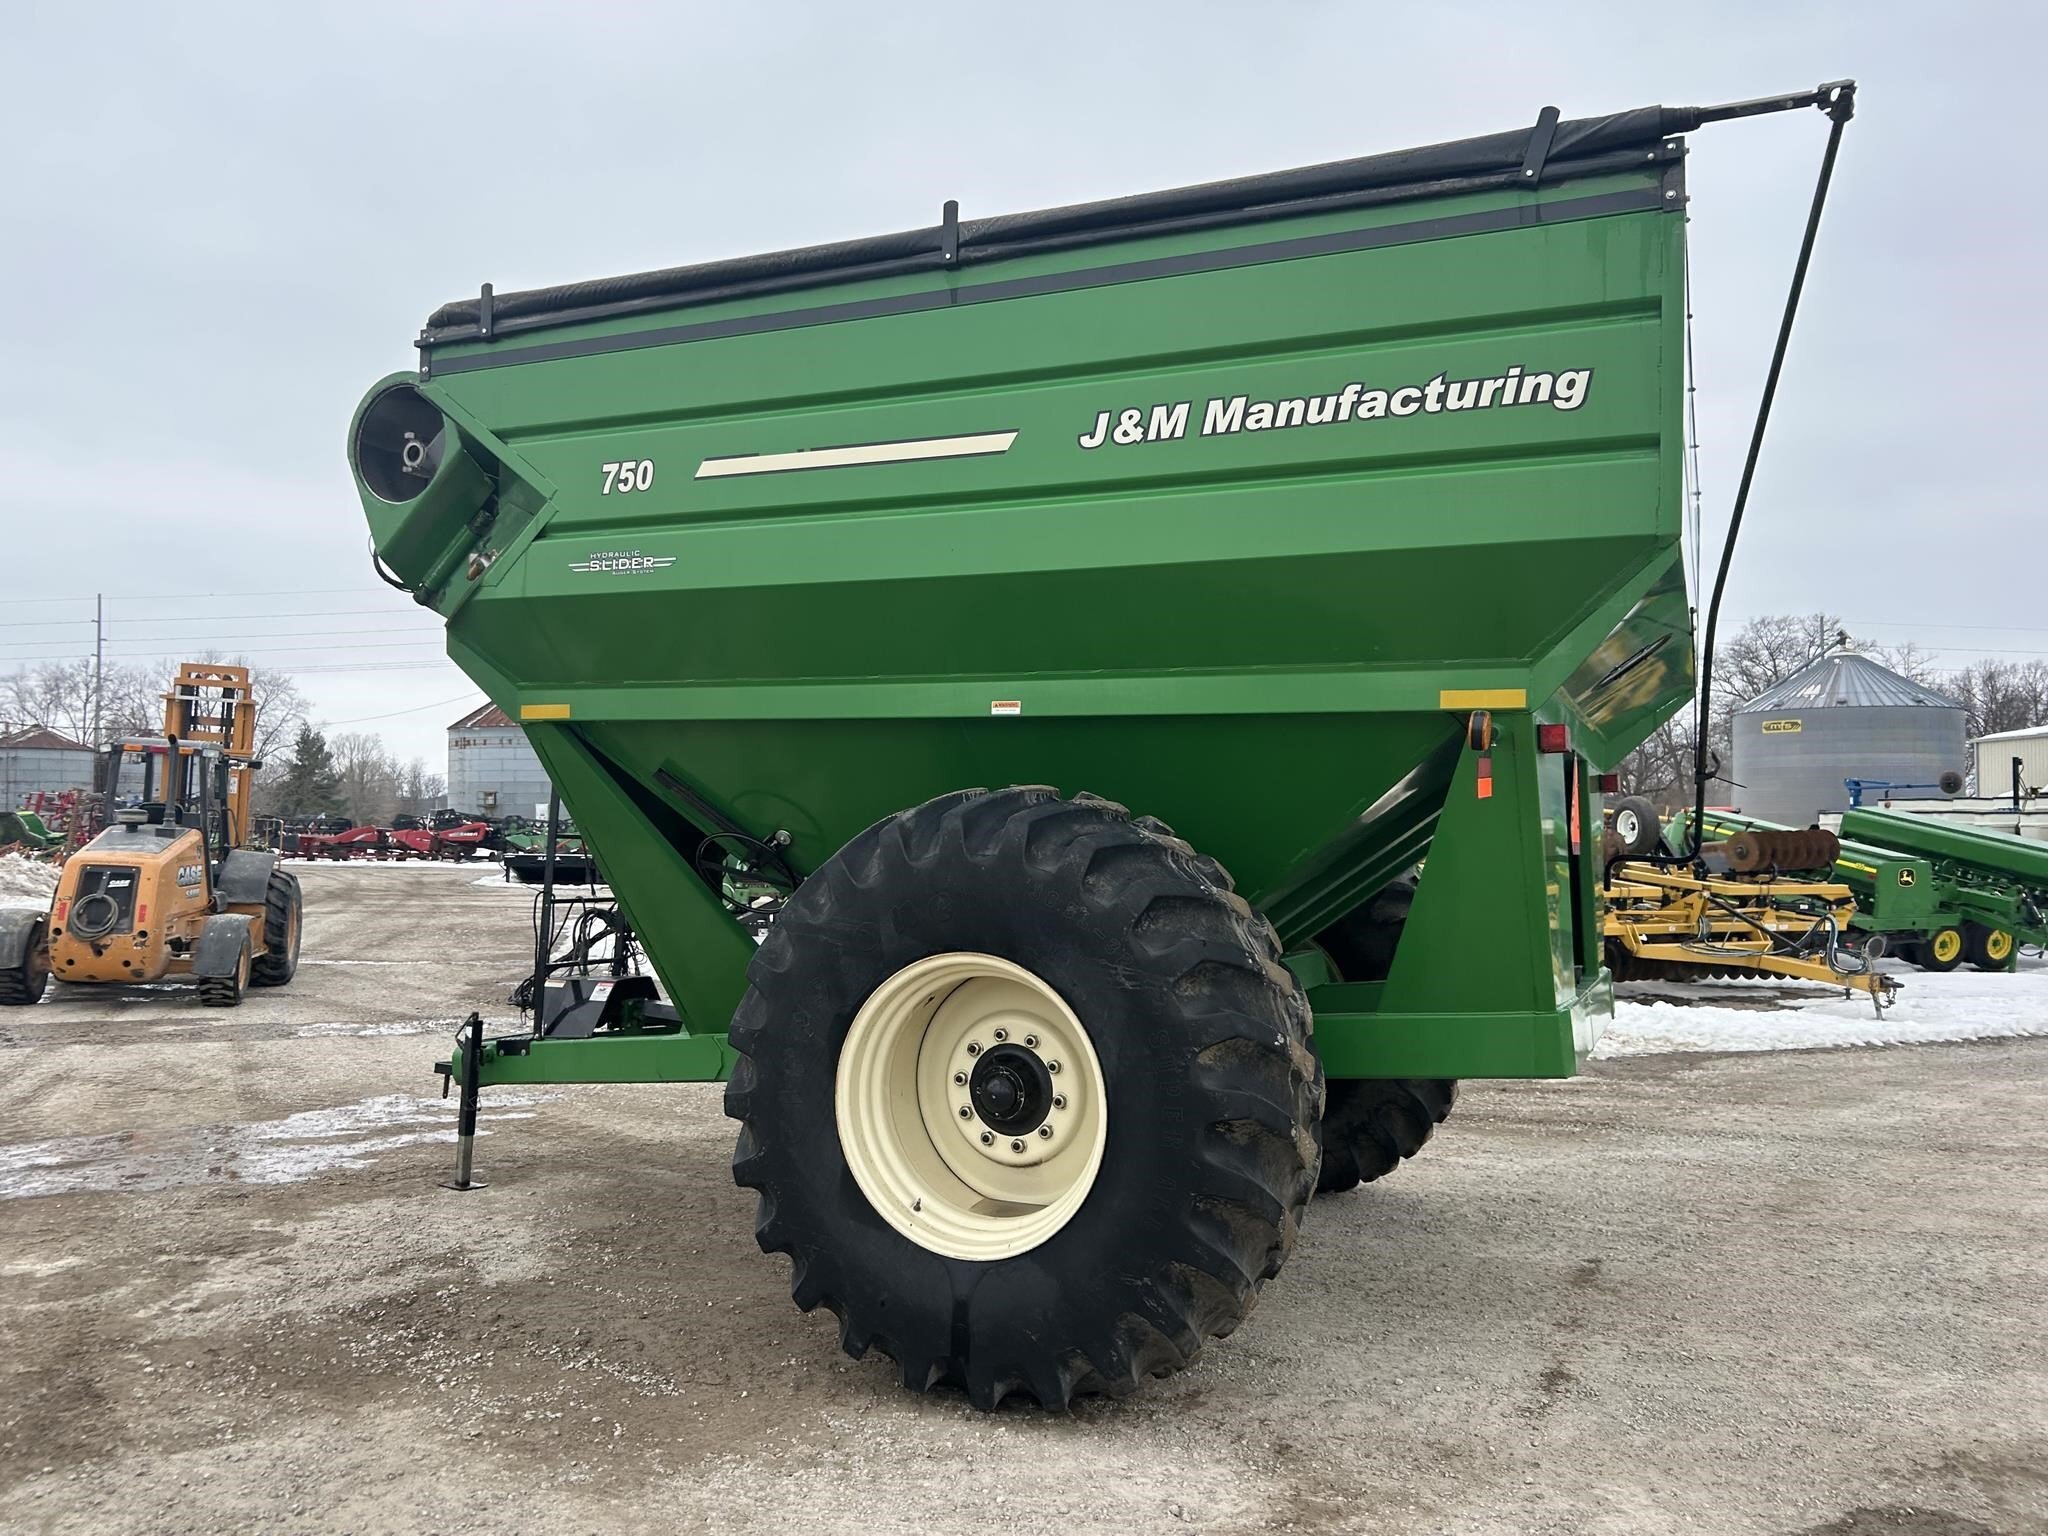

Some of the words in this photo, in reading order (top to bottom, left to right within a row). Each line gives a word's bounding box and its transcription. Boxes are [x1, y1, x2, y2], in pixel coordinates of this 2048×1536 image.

[1078, 404, 1190, 449] J&M
[1200, 364, 1595, 437] Manufacturing
[601, 459, 654, 495] 750
[589, 557, 654, 571] SLIDER
[590, 550, 641, 559] HYDRAULIC
[177, 864, 203, 883] CASE
